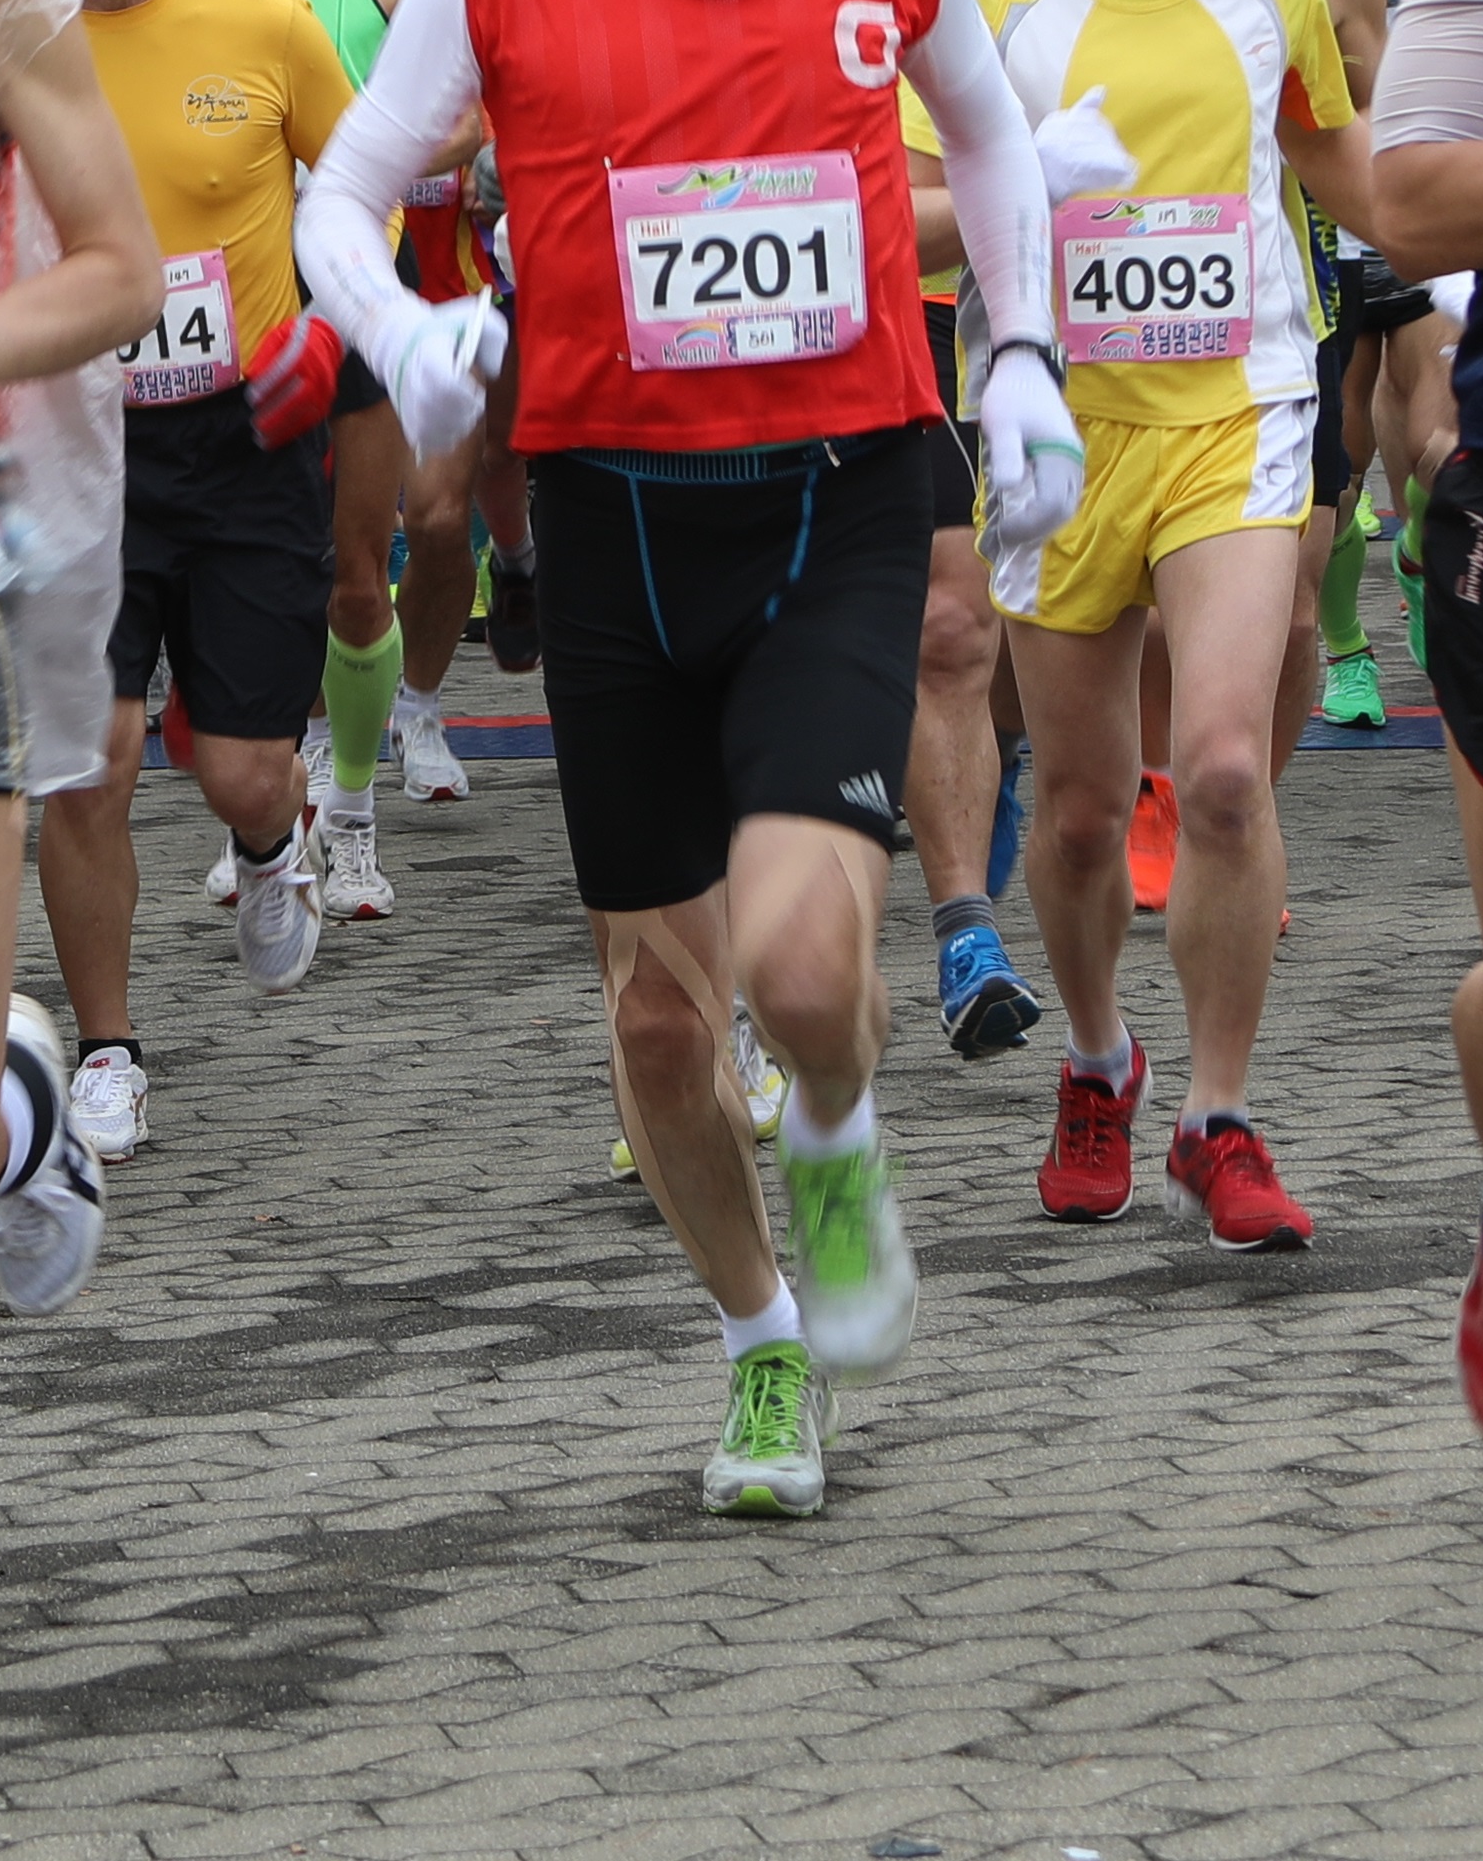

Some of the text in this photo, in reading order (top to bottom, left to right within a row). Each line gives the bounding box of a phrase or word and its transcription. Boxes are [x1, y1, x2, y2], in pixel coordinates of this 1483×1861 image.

[640, 220, 671, 237] Half
[1075, 243, 1101, 255] Half
[638, 230, 829, 309] 7201
[1073, 254, 1235, 313] 4093
[1141, 321, 1229, 357] 용담댐관리단
[132, 362, 214, 401] 용담댐관리단
